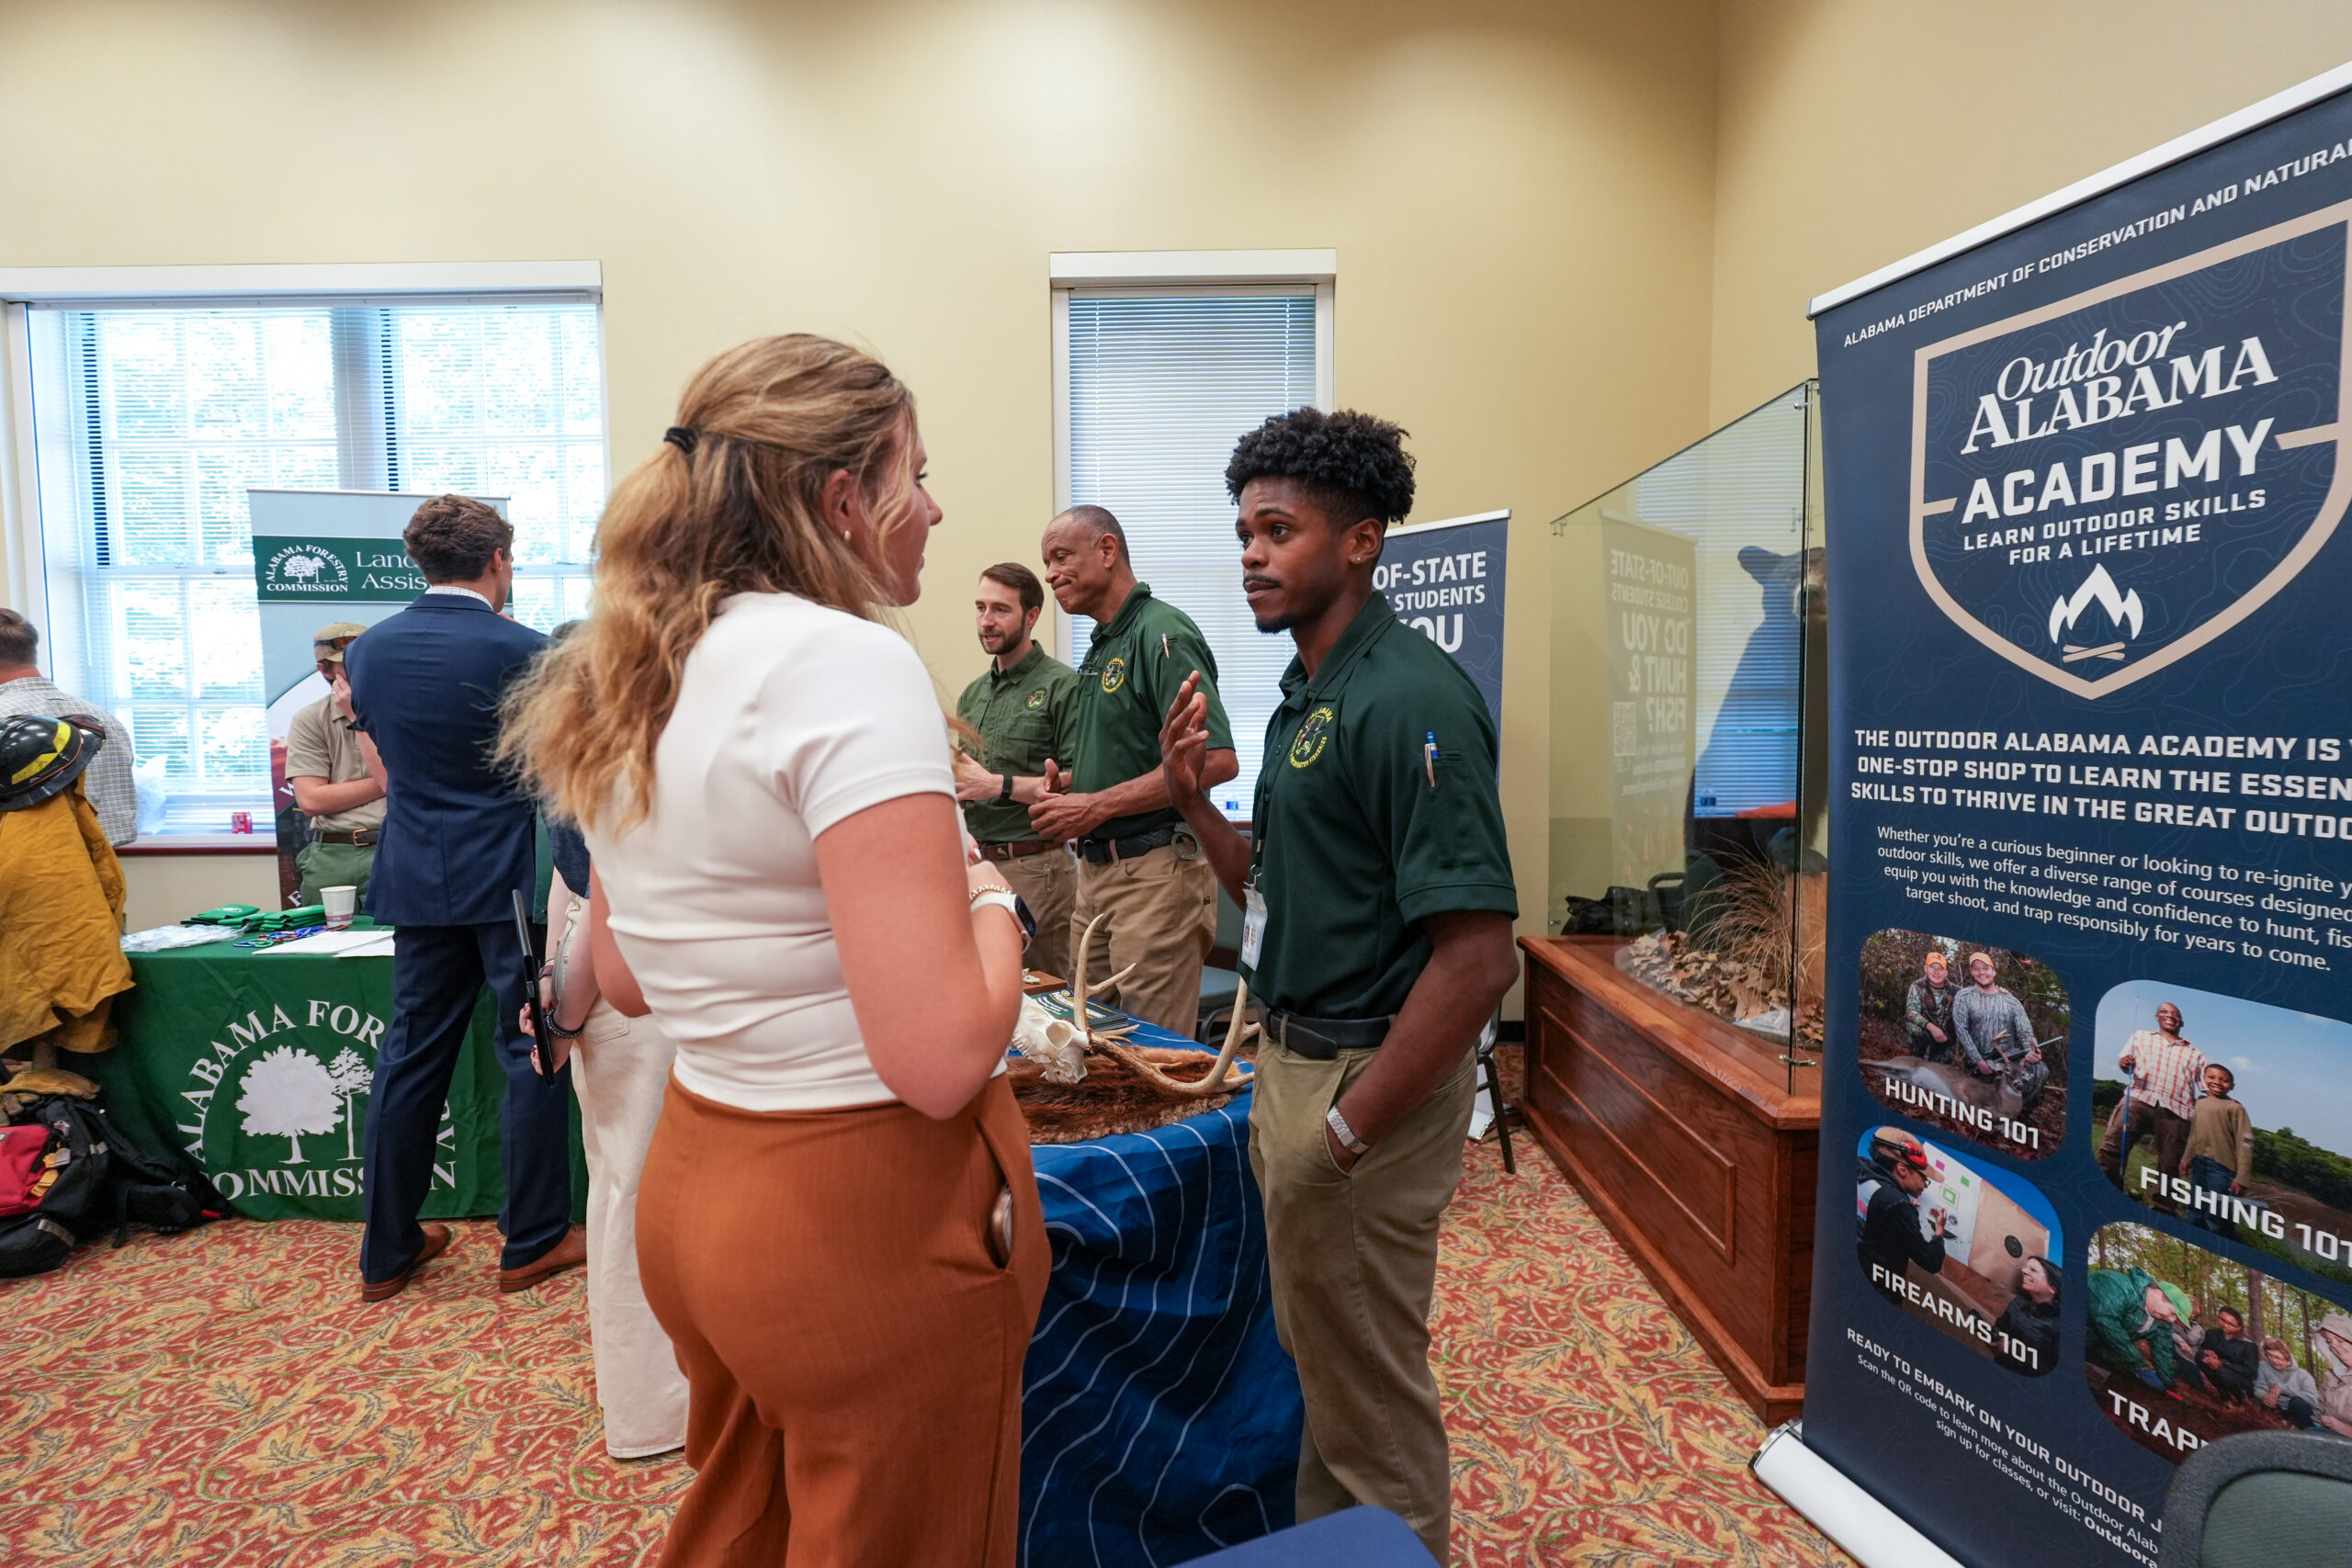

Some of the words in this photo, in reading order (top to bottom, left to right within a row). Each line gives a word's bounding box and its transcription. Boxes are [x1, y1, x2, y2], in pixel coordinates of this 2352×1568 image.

[1843, 313, 1905, 348] ALABAMA
[1908, 272, 2009, 323] DEPARTMENT
[2011, 262, 2035, 284] OF
[2038, 204, 2186, 274] CONSERVATION
[2189, 184, 2238, 217] AND
[1960, 336, 2278, 455] ALABAMA
[1996, 320, 2187, 401] Outdoor
[1961, 417, 2276, 525] ACADEMY
[1963, 525, 2035, 551] LEARN
[2042, 506, 2154, 540] OUTDOOR
[2165, 489, 2267, 522] SKILLS
[2008, 545, 2052, 566] FOR
[2057, 542, 2074, 559] A
[2081, 523, 2201, 557] LIFETIME
[266, 545, 303, 582] ALABAMA
[305, 544, 349, 583] FORESTRY
[266, 583, 348, 592] COMMISSION
[361, 572, 428, 590] Assis
[1395, 584, 1486, 612] STUDENTS
[1398, 614, 1463, 653] OU
[1854, 729, 1890, 748] THE
[1894, 730, 1998, 750] OUTDOOR
[2003, 731, 2132, 755] ALABAMA
[2138, 734, 2299, 760] ACADEMY
[2306, 738, 2341, 761] IS
[1857, 756, 1959, 778] ONE-STOP
[1963, 760, 2027, 782] SHOP
[2030, 762, 2062, 784] TO
[2069, 764, 2162, 790] LEARN
[2168, 769, 2232, 794] THE
[1850, 782, 1916, 804] SKILLS
[1918, 786, 1948, 806] TO
[1951, 788, 2037, 813] THRIVE
[2042, 795, 2069, 816] IN
[2073, 796, 2127, 821] THE
[2134, 801, 2237, 829] GREAT
[1877, 825, 1930, 844] Whether
[1978, 839, 1987, 851] a
[1991, 839, 2042, 857] curious
[2046, 842, 2117, 866] beginner
[2120, 855, 2140, 869] or
[2143, 853, 2213, 882] looking
[2217, 864, 2240, 881] to
[2245, 869, 2335, 893] re-ignite
[1877, 846, 1927, 863] outdoor
[1928, 850, 1965, 869] skills,
[1968, 857, 1990, 871] we
[1993, 858, 2028, 875] offer
[2030, 865, 2040, 877] a
[2043, 863, 2098, 886] diverse
[2103, 875, 2153, 896] range
[2156, 880, 2177, 897] of
[2180, 886, 2256, 908] courses
[1883, 865, 1918, 883] equip
[1921, 871, 1946, 885] you
[1949, 873, 1980, 889] with
[1983, 876, 2007, 893] the
[2009, 879, 2092, 908] knowledge
[2095, 896, 2128, 912] and
[2132, 902, 2233, 929] confidence
[2238, 916, 2260, 933] to
[2266, 918, 2320, 946] hunt,
[1905, 886, 1945, 904] target
[1947, 890, 1989, 912] shoot,
[1993, 900, 2020, 916] and
[2023, 904, 2053, 925] trap
[2057, 911, 2150, 942] responsibly
[2153, 924, 2181, 943] for
[2184, 933, 2236, 953] years
[2241, 941, 2263, 958] to
[2267, 948, 2332, 972] come.
[175, 1003, 298, 1165] ALABAMA
[1885, 1077, 1993, 1132] HUNTING
[1998, 1116, 2039, 1150] 101
[2141, 1166, 2285, 1240] FISHING
[2295, 1223, 2352, 1268] 101
[1871, 1262, 1993, 1344] FIREARMS
[1997, 1331, 2038, 1371] 101
[1847, 1327, 1891, 1362] READY
[1892, 1354, 1911, 1375] TO
[1914, 1368, 1975, 1417] EMBARK
[1979, 1408, 2001, 1433] ON
[2005, 1424, 2051, 1464] YOUR
[2054, 1456, 2145, 1524] OUTDOOR
[1858, 1354, 1879, 1375] Scan
[1881, 1369, 1896, 1385] the
[1897, 1379, 1912, 1396] QR
[1914, 1392, 1938, 1412] code
[1939, 1406, 1951, 1420] to
[1952, 1413, 1978, 1439] learn
[1981, 1434, 2008, 1459] more
[2010, 1455, 2045, 1483] about
[2047, 1476, 2068, 1497] the
[2070, 1491, 2125, 1532] Outdoor
[2126, 1527, 2159, 1554] Alab
[2107, 1388, 2211, 1451] TRAP
[1936, 1420, 1957, 1439] sign
[1959, 1435, 1973, 1450] up
[1974, 1443, 1991, 1461] for
[1992, 1458, 2033, 1492] classes,
[2036, 1487, 2050, 1500] or
[2052, 1496, 2081, 1522] visit:
